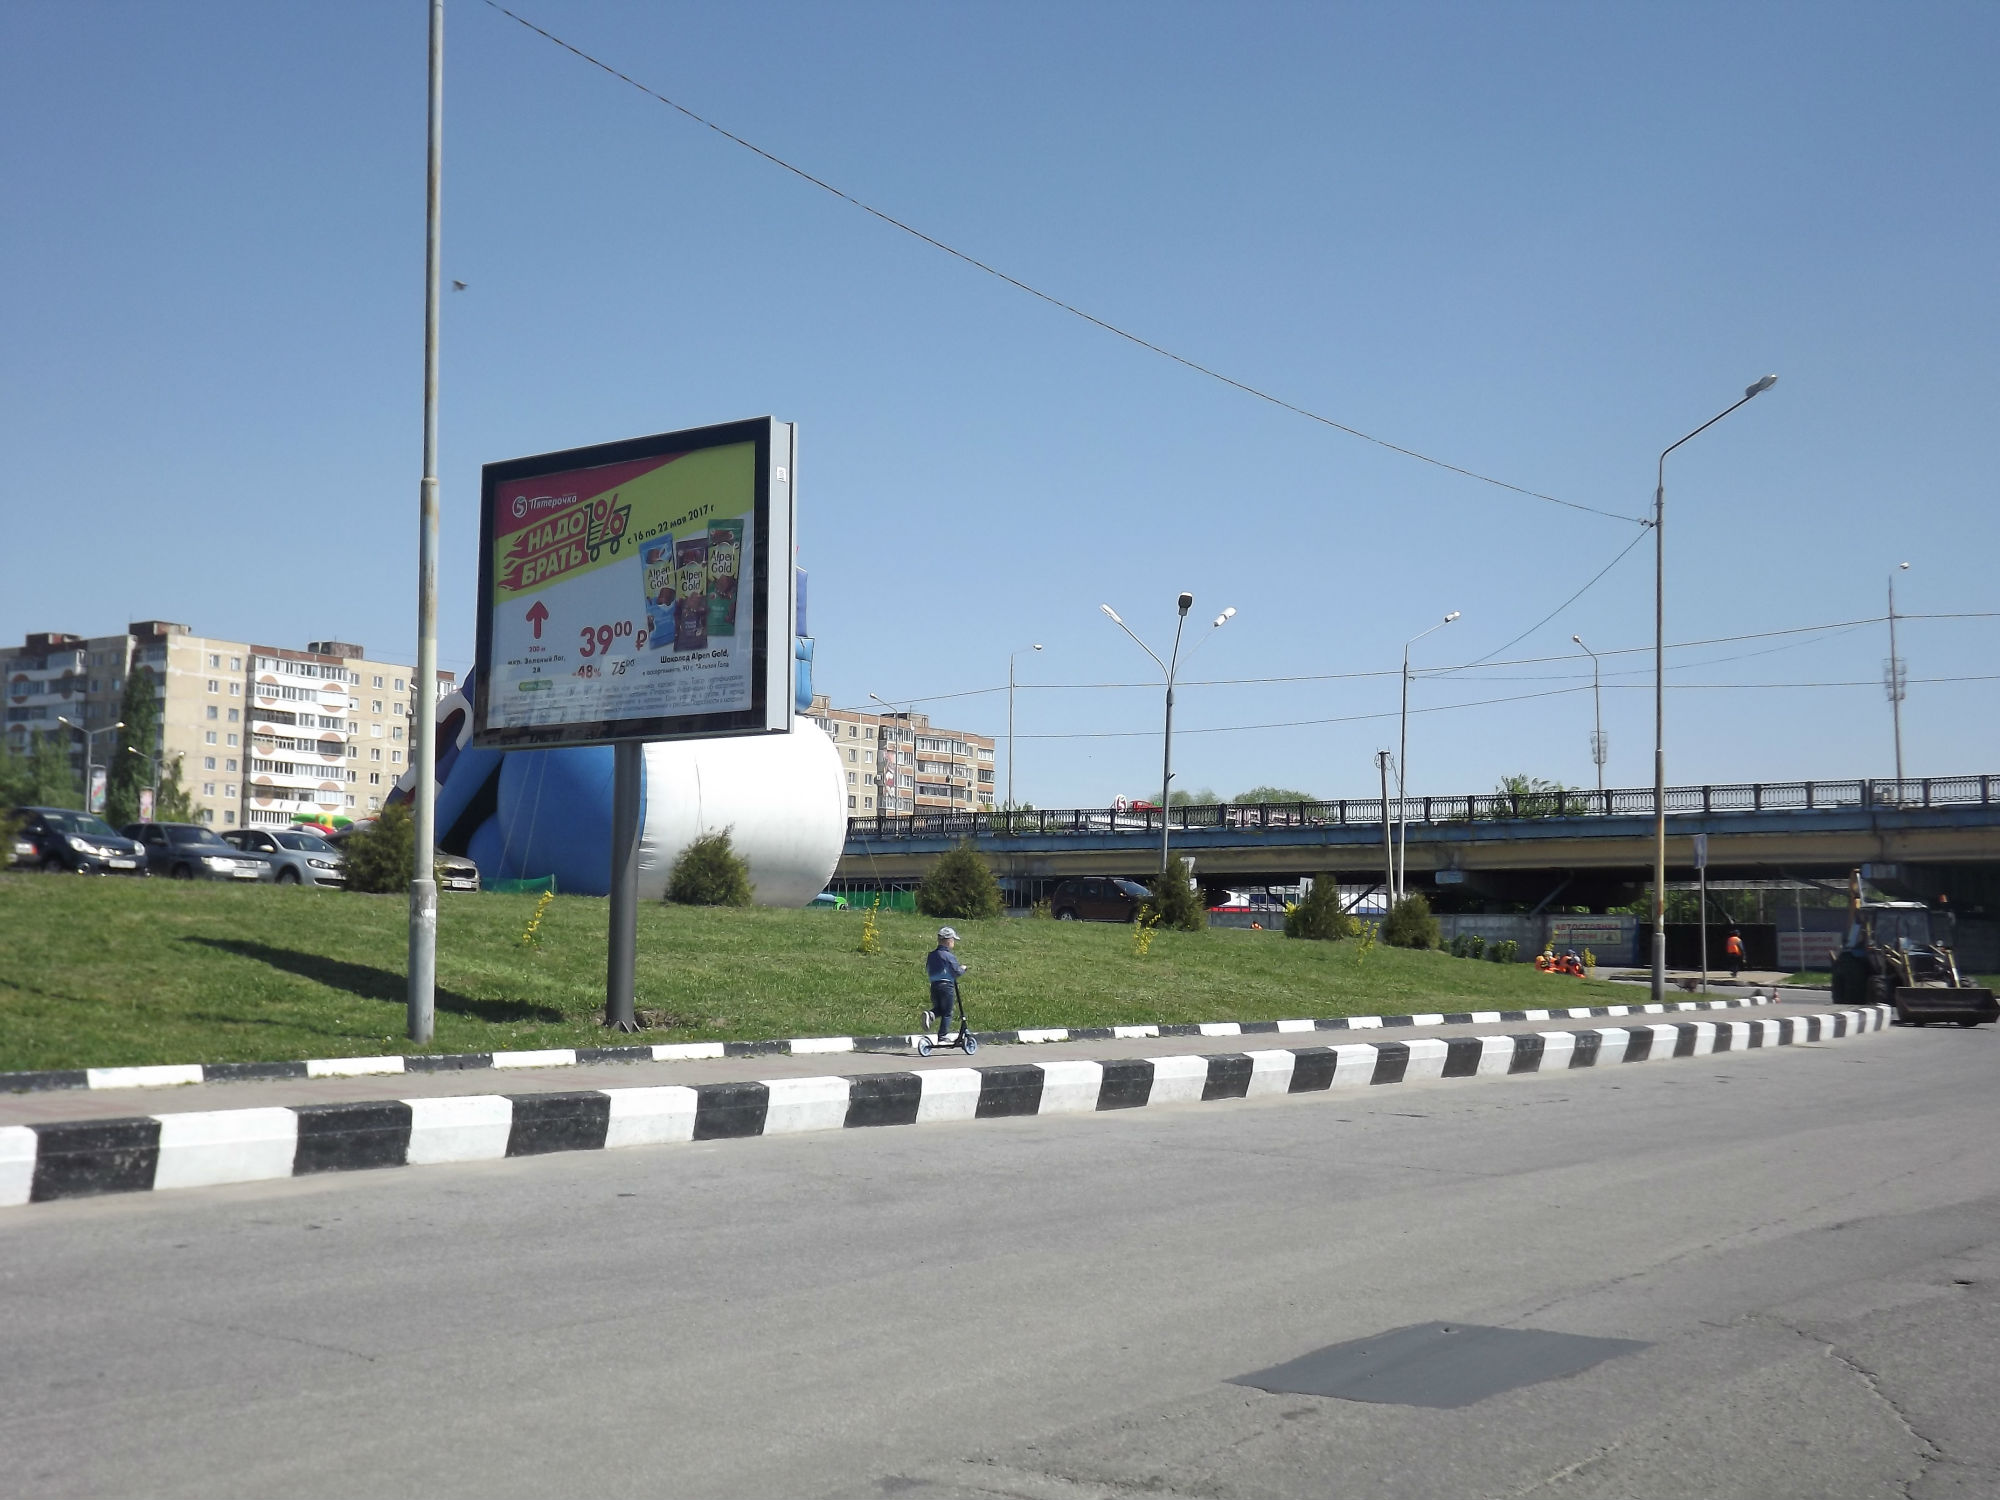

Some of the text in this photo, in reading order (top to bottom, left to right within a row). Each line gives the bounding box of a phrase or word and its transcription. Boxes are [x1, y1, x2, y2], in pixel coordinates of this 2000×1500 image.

[634, 531, 644, 542] 16
[645, 529, 657, 539] по
[657, 521, 669, 532] 22
[670, 516, 687, 528] мая
[688, 504, 709, 521] 2017
[528, 511, 585, 553] НАДО
[710, 549, 735, 562] Alpen
[521, 544, 583, 585] БРАТЬ
[711, 562, 733, 574] Gold
[647, 565, 671, 580] Alpen
[680, 570, 703, 582] Alpen
[650, 577, 669, 591] Gold
[681, 581, 701, 592] Gold
[660, 649, 729, 665] Шоколад Alpen Gold,
